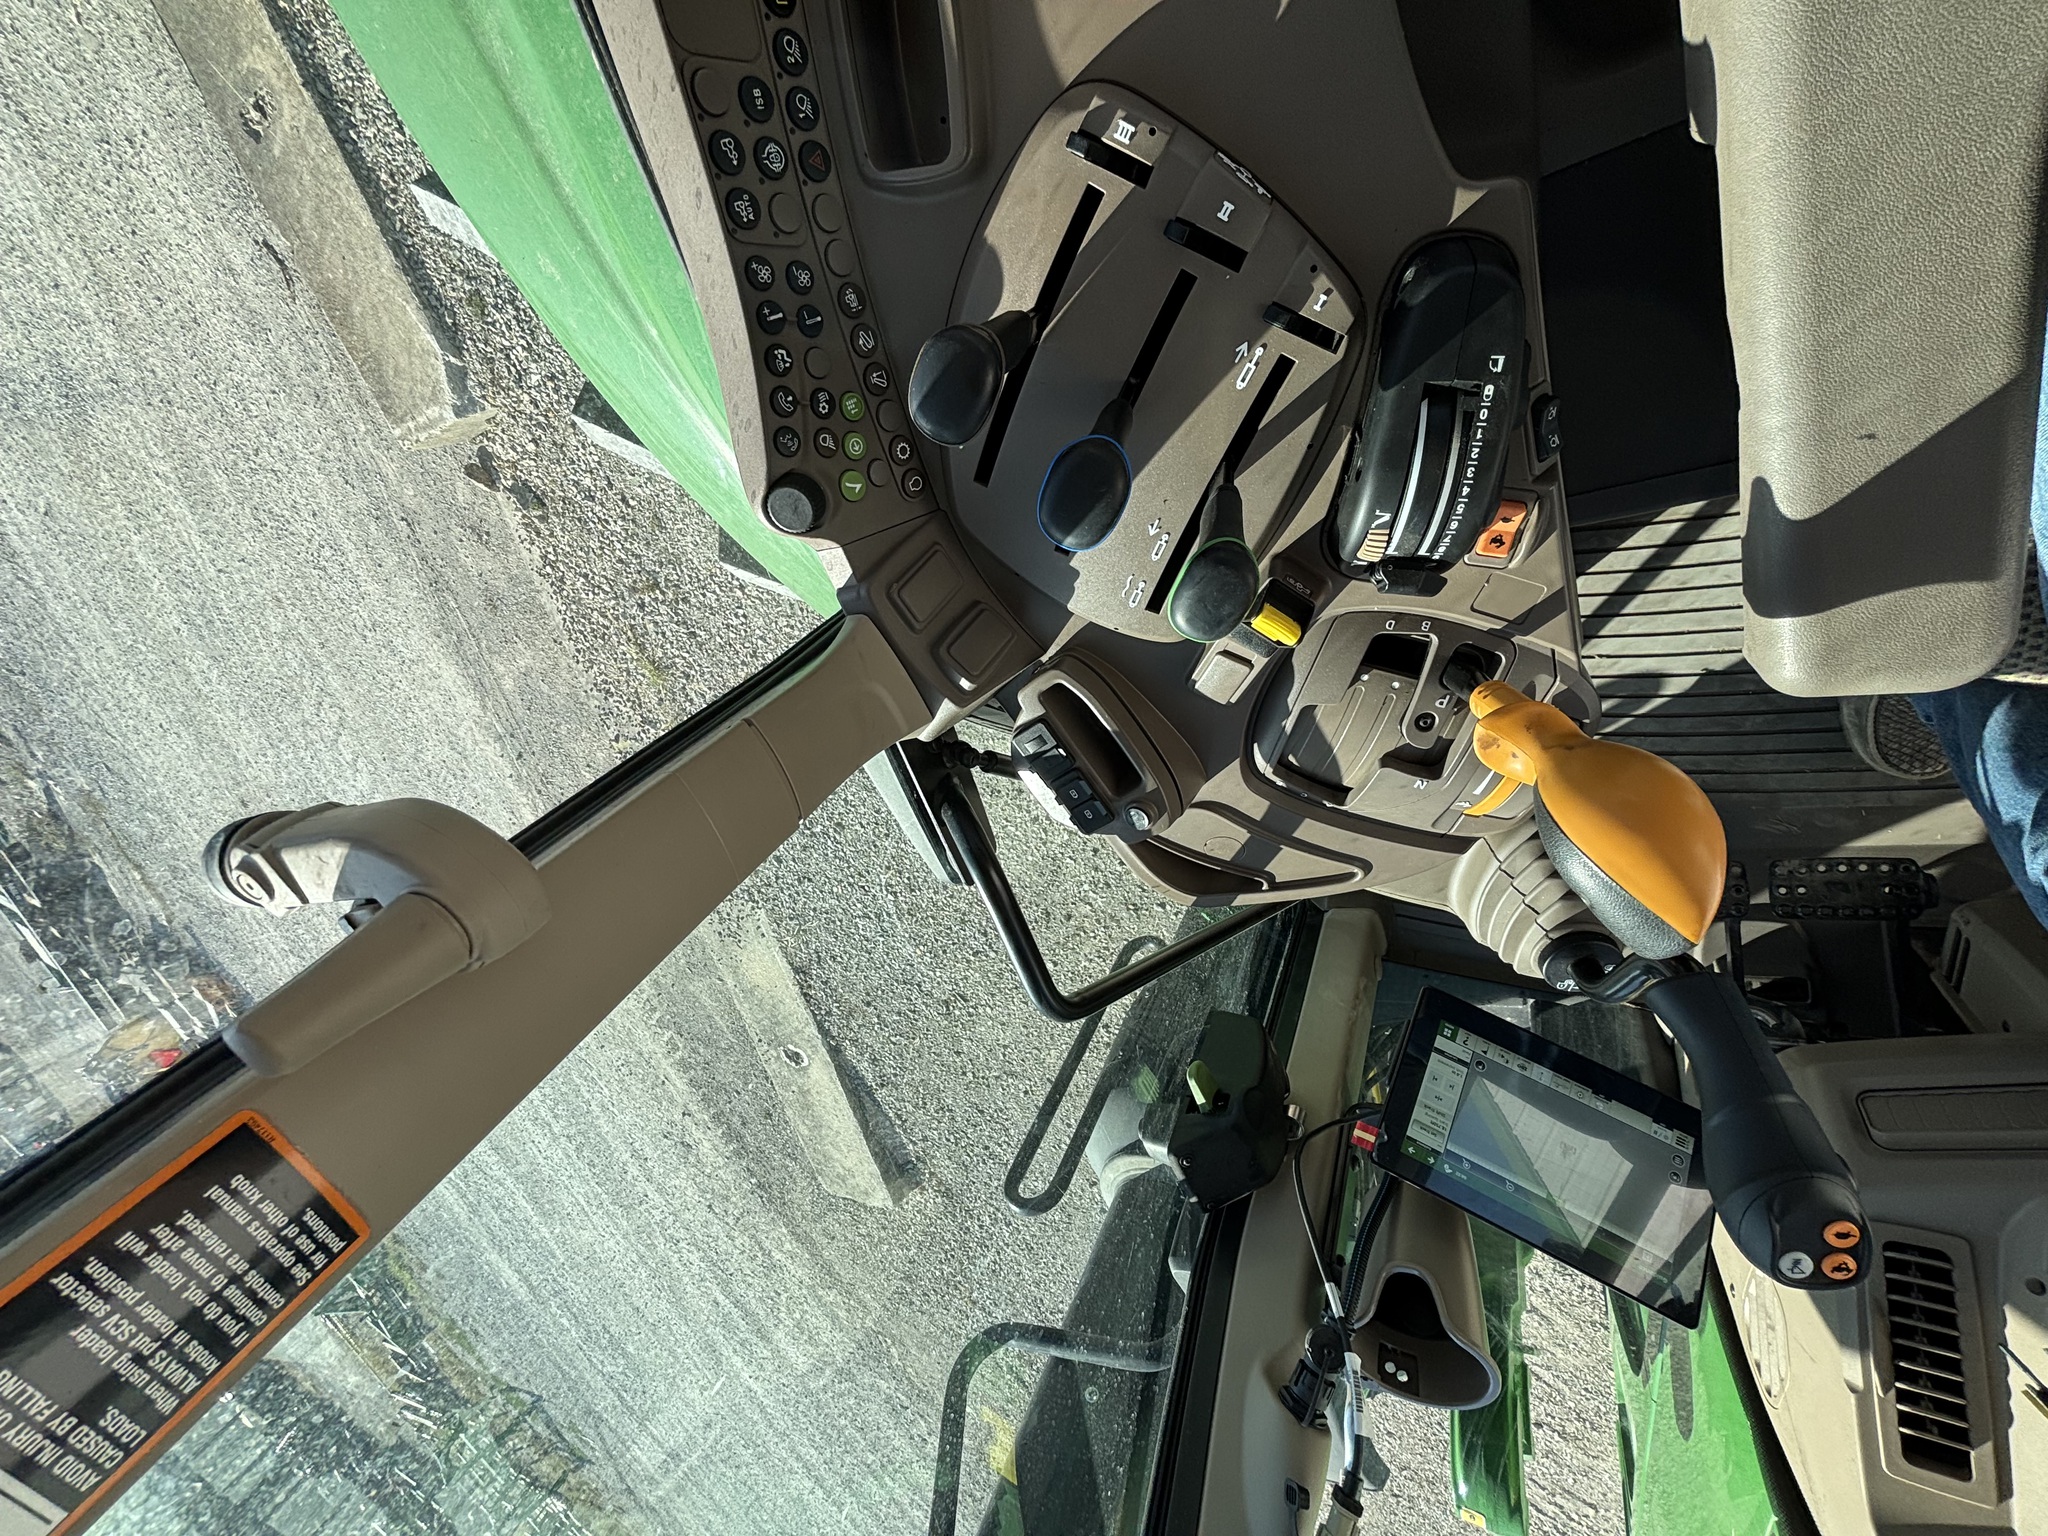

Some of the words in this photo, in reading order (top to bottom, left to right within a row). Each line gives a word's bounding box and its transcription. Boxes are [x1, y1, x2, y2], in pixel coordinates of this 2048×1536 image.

[786, 55, 795, 64] 2
[752, 88, 765, 110] ISB
[1113, 119, 1136, 145] III
[742, 194, 755, 220] AUTO
[1217, 200, 1235, 222] II
[1313, 294, 1328, 312] I
[1479, 408, 1489, 419] 0
[1475, 428, 1483, 439] 1
[1470, 448, 1479, 458] 2
[1466, 467, 1475, 478] 3
[1461, 485, 1471, 496] 4
[1455, 504, 1465, 514] 5
[1449, 520, 1459, 530] 6
[1437, 545, 1447, 553] 8
[1443, 534, 1452, 543] 7
[1385, 620, 1396, 631] D
[1421, 620, 1431, 631] B
[1434, 694, 1451, 709] P
[1413, 779, 1429, 790] N
[230, 1174, 264, 1205] knob
[203, 1185, 253, 1226] manual
[257, 1199, 289, 1228] other
[150, 1223, 186, 1252] after
[176, 1210, 232, 1259] released.
[280, 1223, 300, 1238] of
[302, 1207, 347, 1253] positions.
[114, 1231, 149, 1257] will
[246, 1220, 296, 1267] operators
[294, 1234, 316, 1255] use
[142, 1252, 187, 1291] loader
[180, 1247, 217, 1279] move
[226, 1253, 250, 1275] are
[310, 1251, 329, 1271] for
[84, 1256, 146, 1306] position.
[210, 1274, 228, 1292] to
[290, 1263, 312, 1287] See
[50, 1272, 112, 1318] selector
[181, 1280, 209, 1307] not,
[243, 1269, 285, 1309] controls
[203, 1301, 223, 1320] do
[222, 1284, 268, 1327] continue
[100, 1313, 137, 1342] SCV
[134, 1300, 178, 1339] loader
[216, 1313, 245, 1337] you
[69, 1324, 119, 1365] loader
[128, 1332, 162, 1356] put
[172, 1330, 191, 1350] in
[231, 1331, 250, 1347] If
[111, 1352, 151, 1388] using
[184, 1340, 221, 1376] knobs
[148, 1349, 202, 1394] ALWAYS
[144, 1380, 180, 1415] When
[46, 1412, 78, 1436] BY
[98, 1405, 147, 1448] LOADS.
[1, 1422, 64, 1467] INJURY
[67, 1425, 124, 1469] CAUSED
[52, 1455, 102, 1492] AVOID
